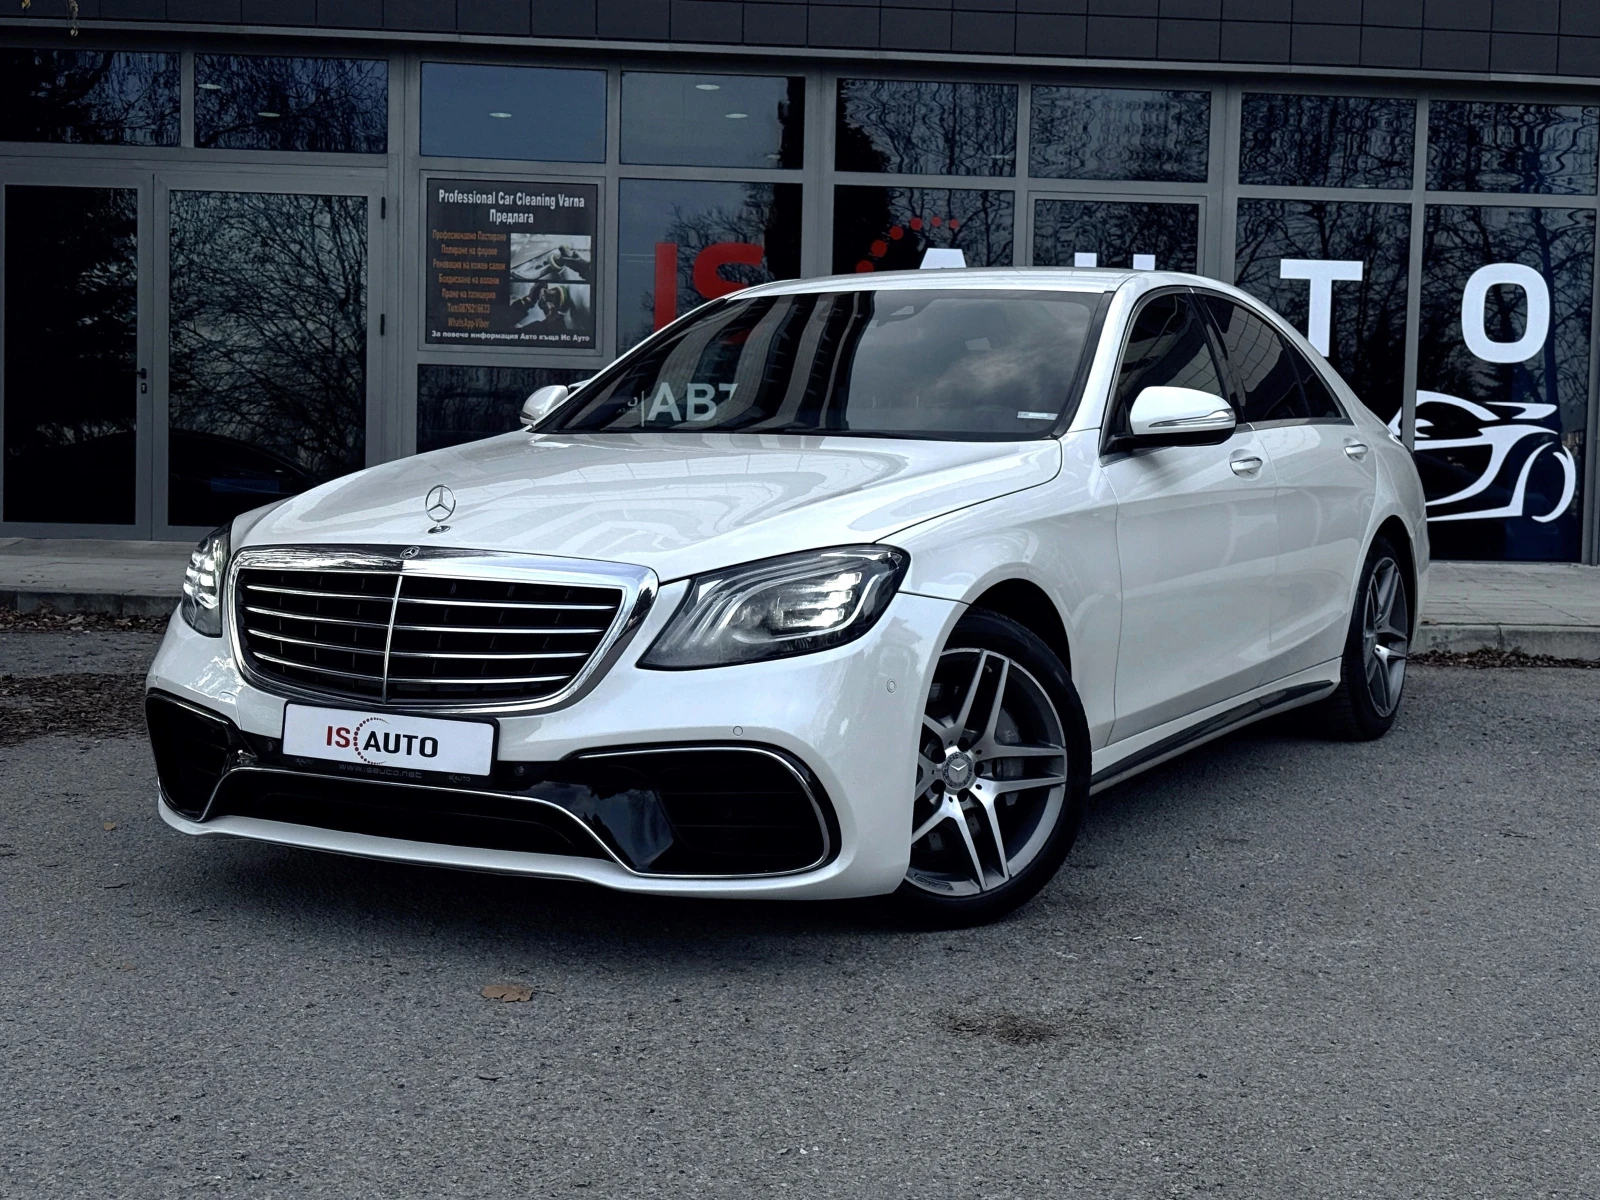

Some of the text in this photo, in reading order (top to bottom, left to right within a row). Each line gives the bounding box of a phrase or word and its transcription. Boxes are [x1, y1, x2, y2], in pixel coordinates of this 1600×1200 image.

[438, 189, 585, 210] Professional Car Cleaning Varna
[489, 209, 534, 225] Предлага
[463, 261, 470, 269] на
[472, 276, 479, 284] на
[431, 330, 441, 338] За
[470, 331, 519, 341] информация
[520, 333, 537, 341] Авто
[539, 334, 559, 342] къща
[561, 333, 571, 341] Ис
[572, 334, 590, 343] Ауто
[326, 726, 439, 758] IS AUTO
